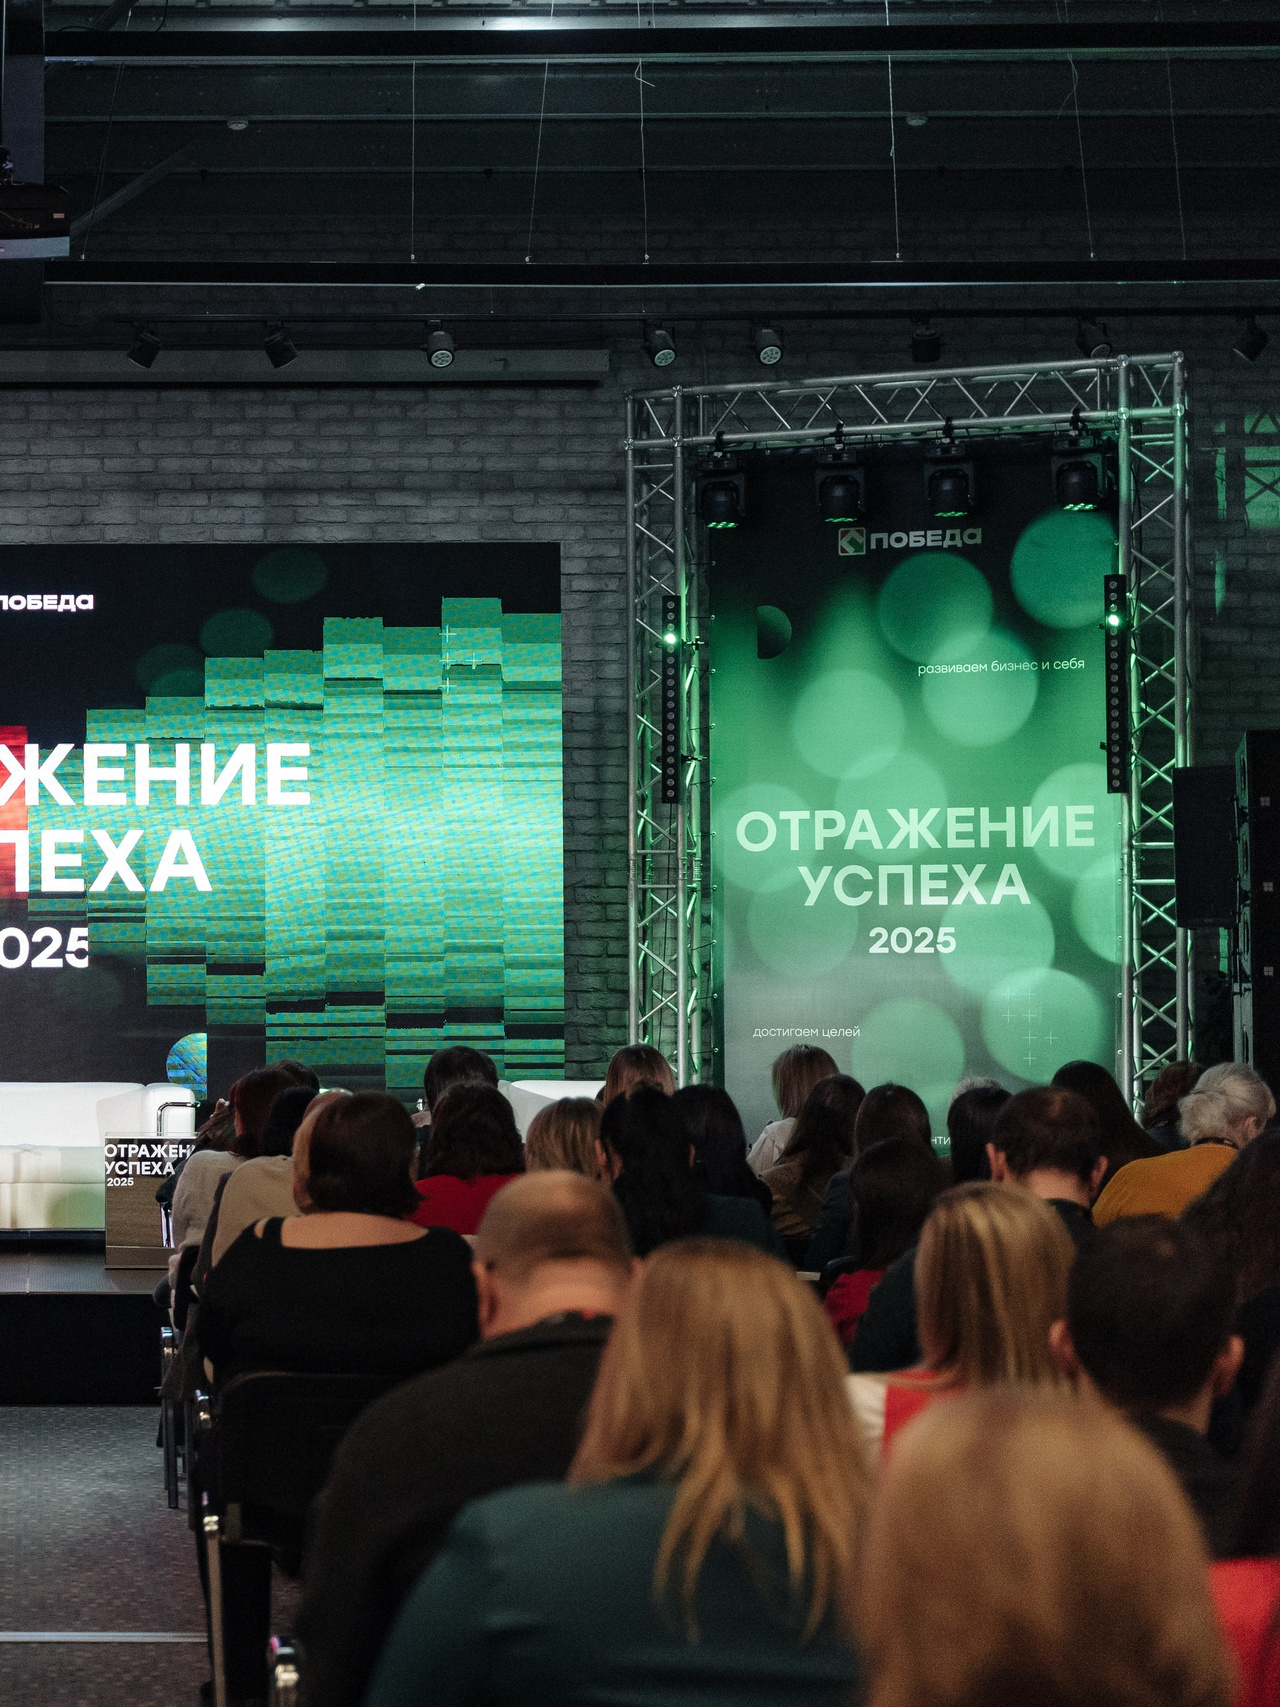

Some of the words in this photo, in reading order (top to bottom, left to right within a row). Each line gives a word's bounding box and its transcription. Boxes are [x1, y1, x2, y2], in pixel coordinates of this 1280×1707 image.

[918, 661, 988, 677] развиваем
[991, 659, 1039, 673] бизнес
[1041, 661, 1050, 671] и
[1053, 658, 1085, 671] себя
[736, 805, 1095, 852] ОТРАЖЕНИЕ
[797, 863, 1031, 907] УСПЕХА
[868, 927, 957, 954] 2025
[752, 1028, 818, 1038] достигаем
[822, 1026, 861, 1039] целей
[104, 1144, 195, 1158] ОТРАЖЕН
[104, 1161, 175, 1175] УСПЕХА
[107, 1177, 134, 1186] 2025
